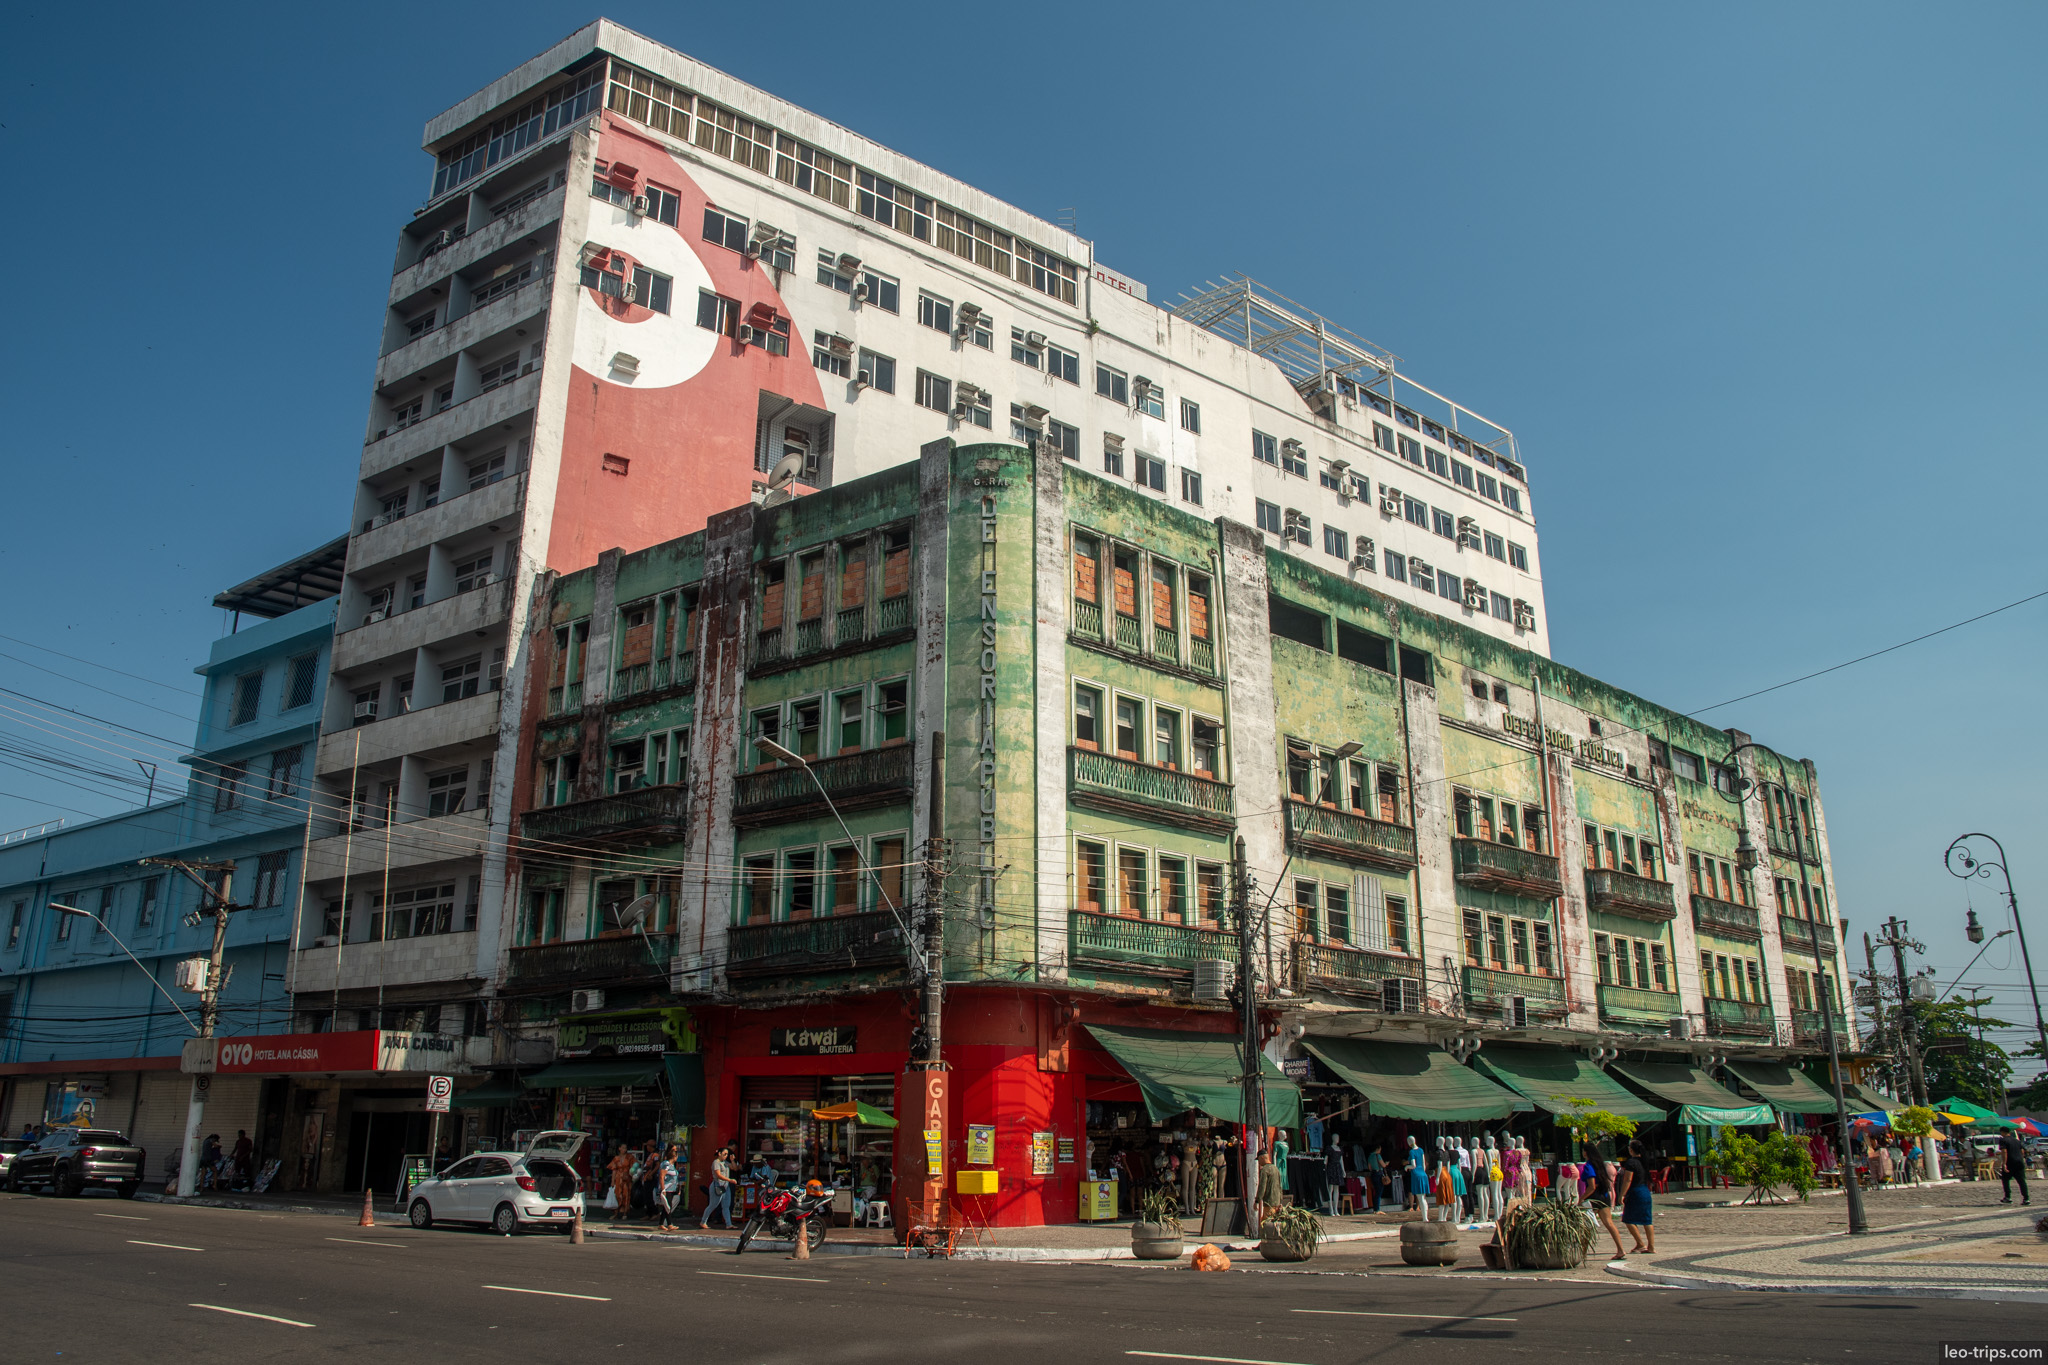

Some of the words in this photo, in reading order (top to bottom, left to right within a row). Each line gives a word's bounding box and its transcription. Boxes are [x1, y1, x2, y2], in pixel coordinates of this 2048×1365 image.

[588, 1024, 622, 1034] VARIEDADES
[624, 1023, 628, 1032] E
[559, 1025, 587, 1047] MB
[599, 1036, 614, 1046] PARA
[615, 1035, 650, 1045] CELULARES
[384, 1036, 409, 1049] ANA
[221, 1043, 253, 1066] OYO
[254, 1049, 276, 1060] HOTEL
[276, 1048, 291, 1060] ANA
[292, 1046, 319, 1060] CÁSSIA
[819, 1045, 854, 1054] BIJUTERIA
[436, 1081, 446, 1093] E
